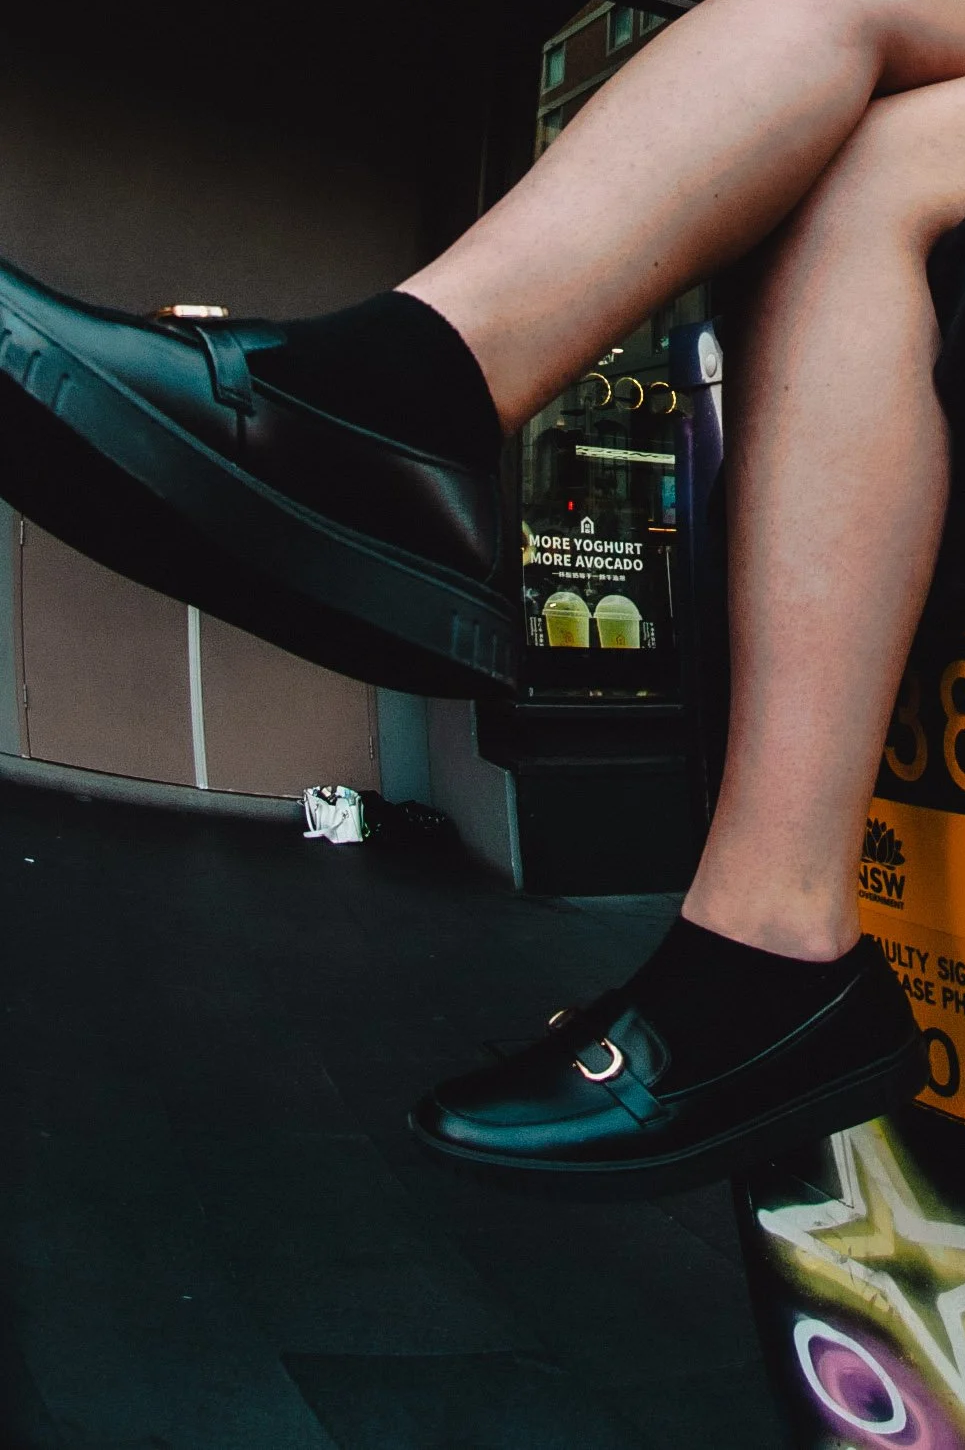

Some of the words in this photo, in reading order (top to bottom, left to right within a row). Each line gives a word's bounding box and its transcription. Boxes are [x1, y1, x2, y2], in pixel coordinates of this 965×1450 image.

[529, 535, 571, 550] MORE
[574, 538, 643, 555] YOGHURT
[530, 552, 571, 566] MORE
[575, 555, 643, 570] AVOCADO
